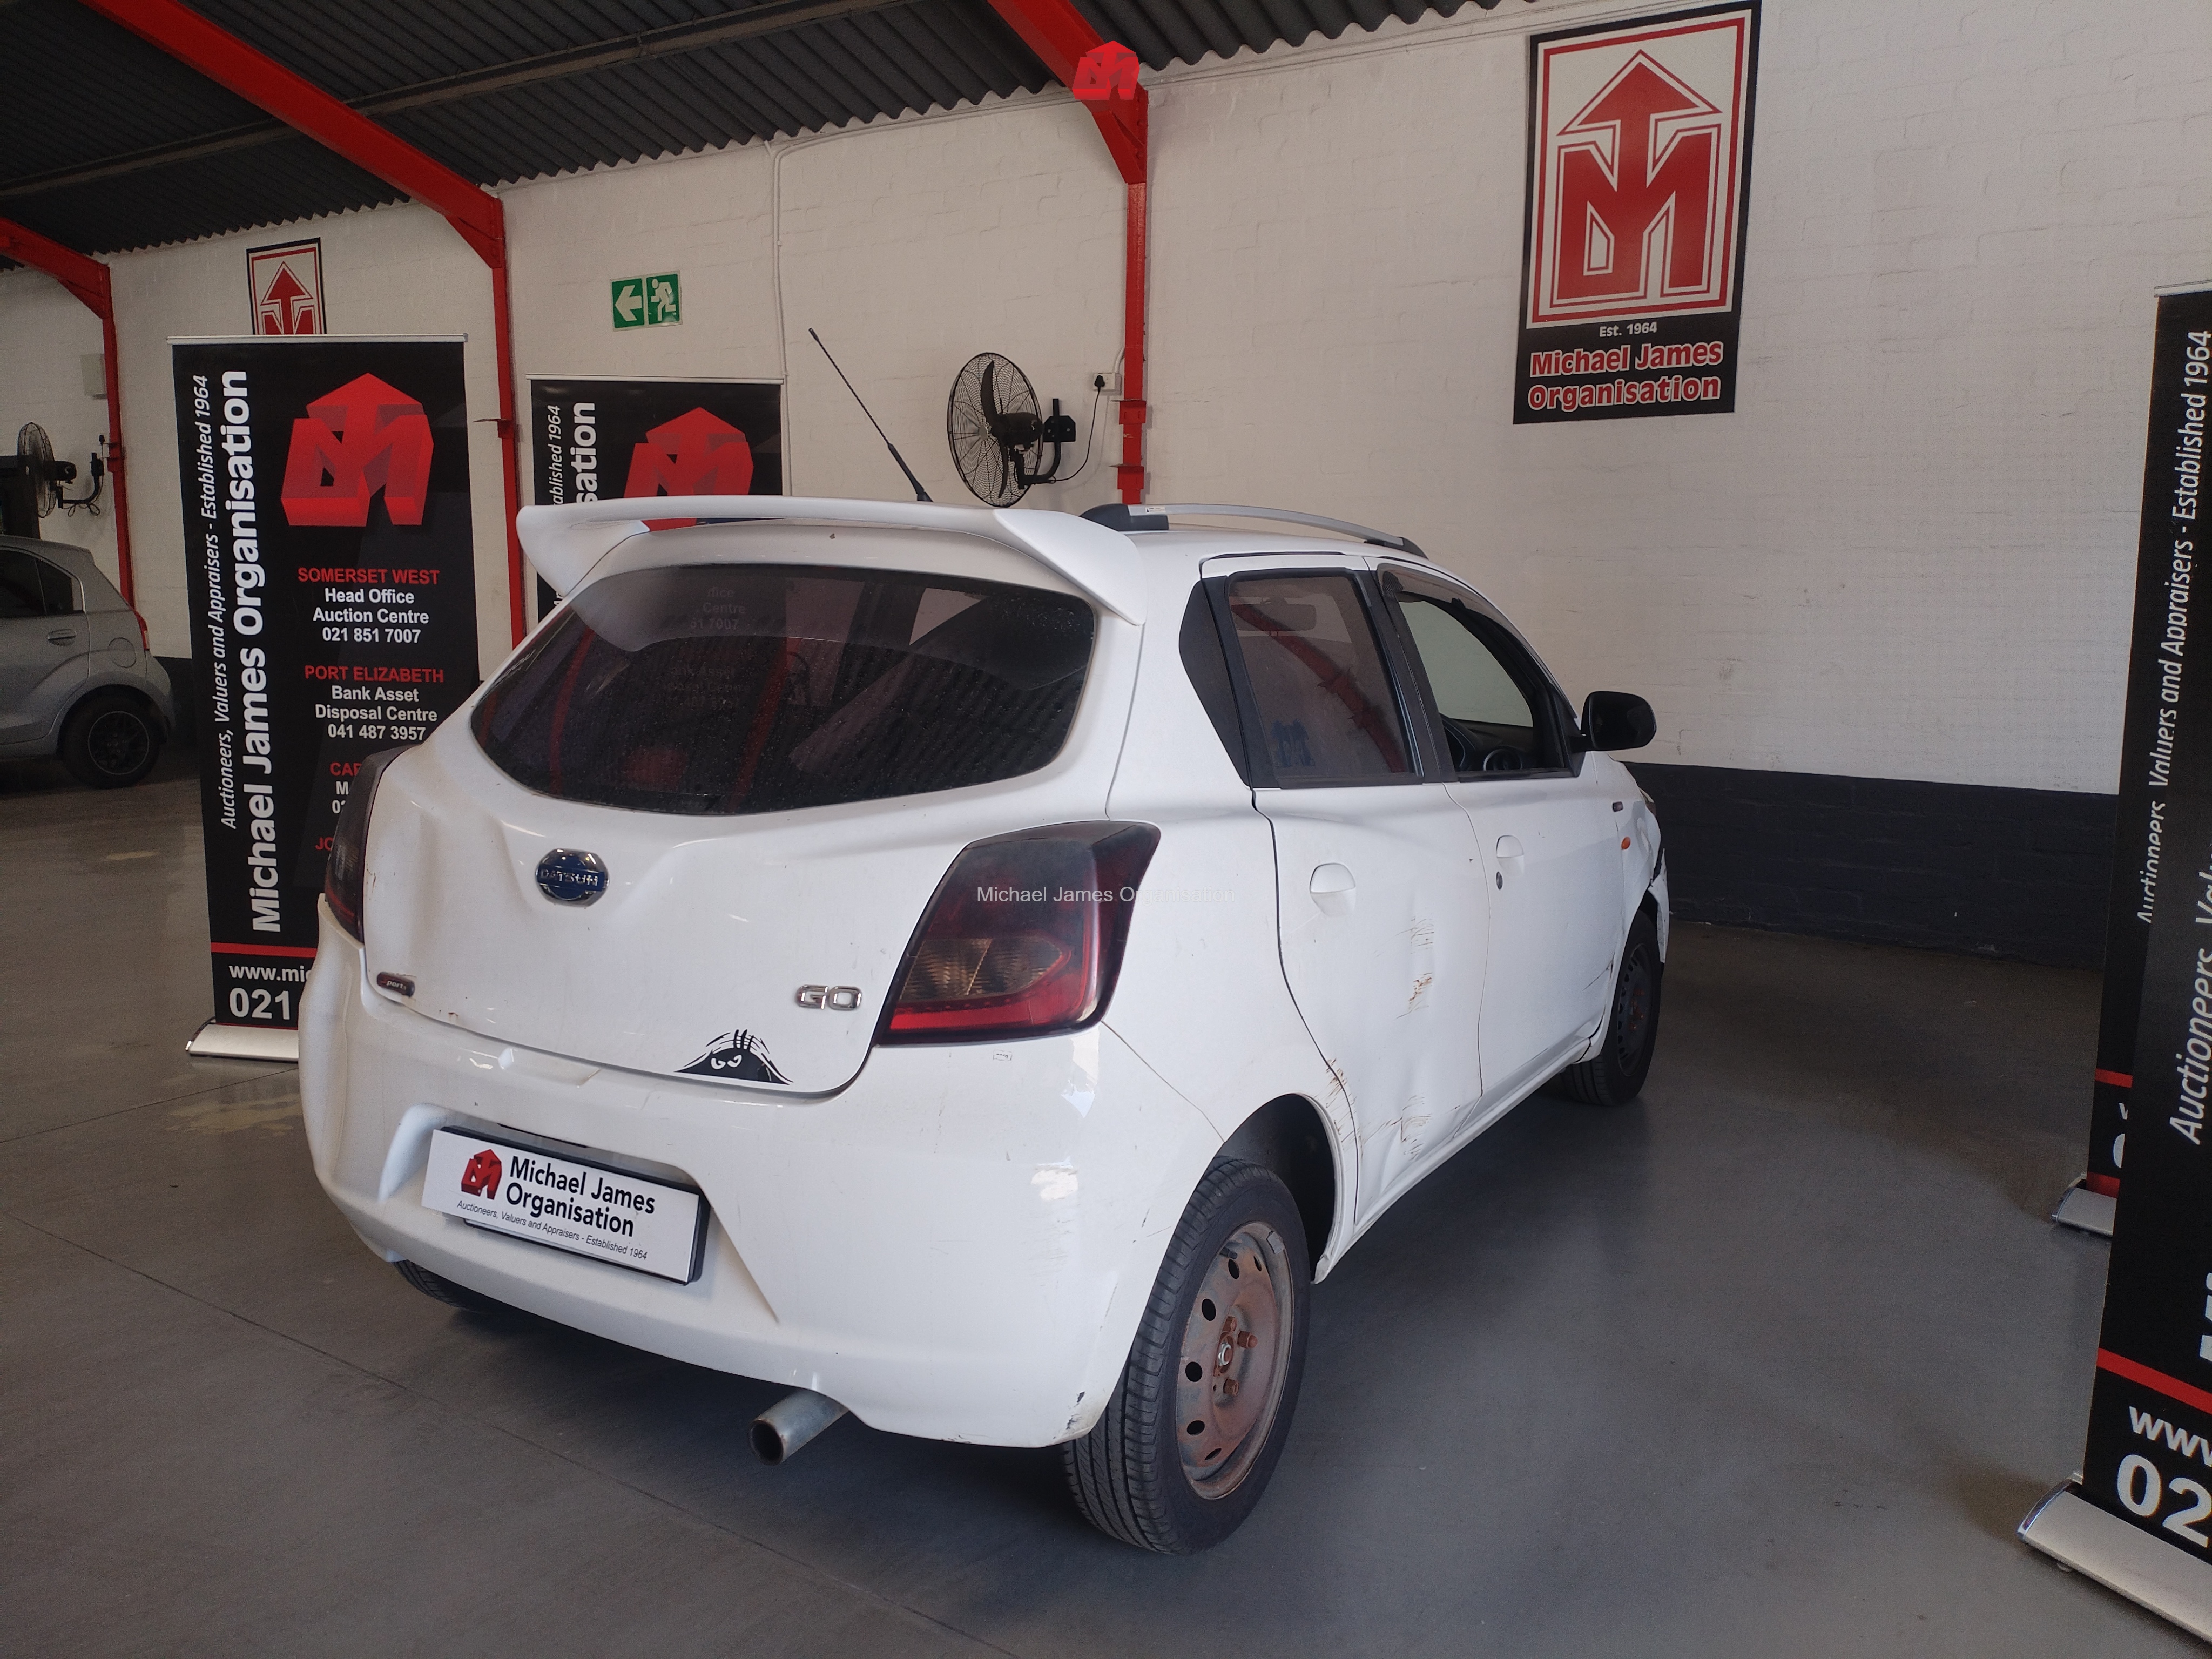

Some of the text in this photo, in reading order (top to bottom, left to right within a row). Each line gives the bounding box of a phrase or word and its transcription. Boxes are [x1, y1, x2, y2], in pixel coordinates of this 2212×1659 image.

[1599, 322, 1657, 338] Est. 1964
[1530, 341, 1724, 377] Michael James
[2184, 331, 2212, 386] 1964
[193, 375, 208, 417] 1964
[1528, 375, 1721, 412] Organisation
[195, 421, 217, 519] Established
[548, 406, 563, 505] ablished 1964
[2171, 393, 2208, 520] Established
[203, 533, 226, 622] Appraisers
[298, 568, 440, 584] SOMERSET WEST
[325, 588, 415, 604] Head Office
[2161, 539, 2193, 656] Appraisers
[313, 608, 429, 624] Auction Centre
[322, 627, 421, 643] 021 851 7007
[208, 625, 226, 657] and
[220, 371, 281, 932] Michael James Organisation
[212, 662, 228, 723] Valuers
[305, 665, 444, 683] PORT ELIZABETH
[2157, 658, 2182, 703] and
[315, 704, 437, 722] Disposal Centre
[332, 686, 419, 702] Bank Asset
[328, 725, 426, 740] 041 487 3957
[2149, 709, 2177, 786] Valuers
[218, 729, 237, 828] Auctioneers,
[332, 800, 346, 814] 0
[230, 988, 290, 1020] 021
[795, 984, 862, 1011] GO
[510, 1156, 655, 1214] Michael James
[506, 1182, 634, 1237] Organisation
[456, 1200, 499, 1219] Auctioneers,
[501, 1211, 527, 1226] Valuers
[528, 1218, 542, 1230] and
[542, 1223, 580, 1242] Appraisers
[586, 1235, 628, 1255] Established
[630, 1248, 648, 1260] 1964
